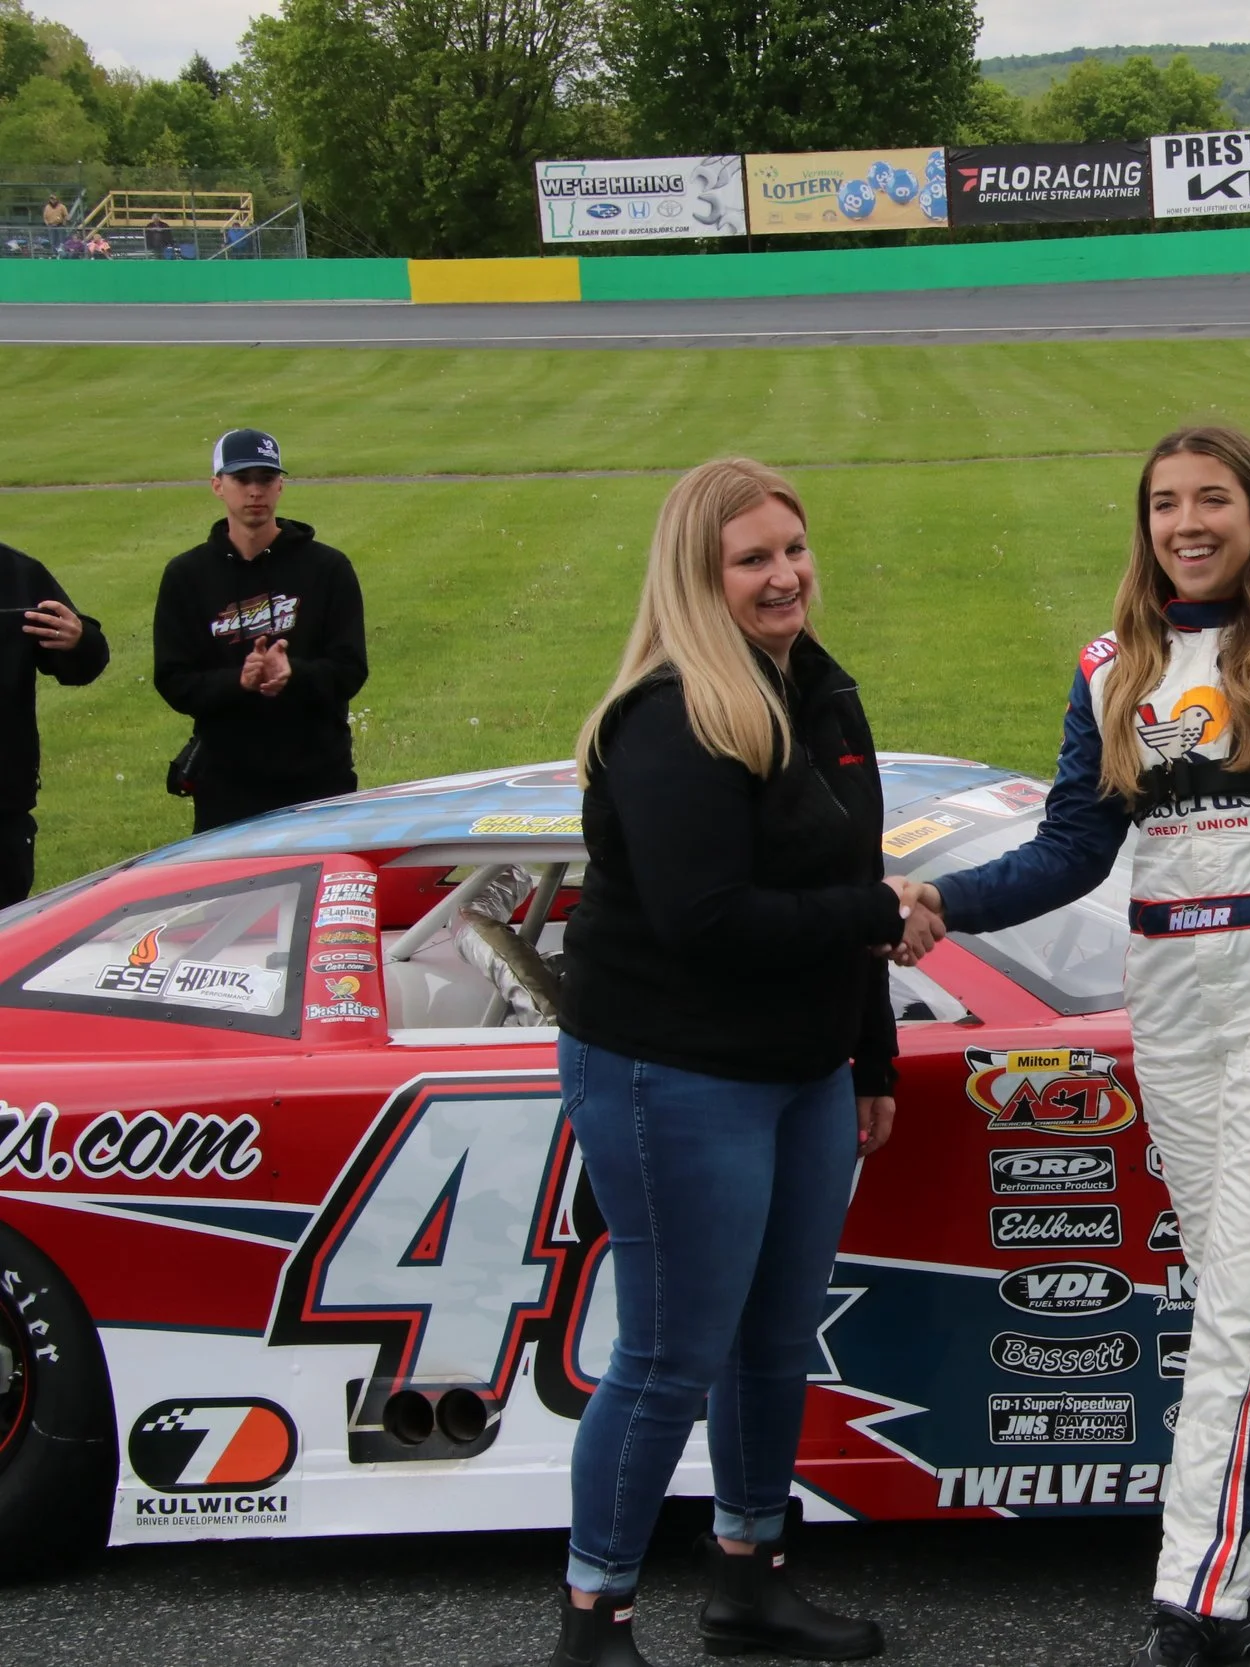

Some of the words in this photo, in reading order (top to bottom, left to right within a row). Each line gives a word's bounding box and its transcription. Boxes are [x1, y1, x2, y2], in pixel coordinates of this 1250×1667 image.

[801, 169, 845, 179] Vermont
[980, 161, 1142, 191] FLORACING
[541, 177, 607, 197] WE'RE
[610, 175, 684, 196] HIRING
[762, 178, 843, 199] LOTTERY
[978, 191, 1023, 203] OFFICIAL
[1026, 190, 1047, 201] LIVE
[1050, 189, 1091, 200] STREAM
[1093, 187, 1140, 199] PARTNER
[1192, 206, 1203, 214] THE
[578, 229, 600, 237] LEARN
[601, 228, 619, 236] MORE
[1147, 824, 1189, 836] CREDIT
[1197, 816, 1249, 831] UNION
[885, 825, 937, 848] Milton
[324, 883, 375, 894] TWELVE
[320, 893, 338, 904] 20
[329, 907, 375, 919] Laplante's
[1169, 906, 1231, 931] HOAR
[319, 953, 371, 962] GOSS
[97, 966, 168, 994] FSE
[200, 990, 250, 1001] PERFORMANCE
[307, 1001, 379, 1019] EastRise
[1017, 1055, 1060, 1068] Milton
[1071, 1053, 1090, 1066] CAT
[996, 1078, 1114, 1122] ACT
[1011, 1158, 1099, 1176] DRP
[1000, 1182, 1062, 1192] Performance
[1064, 1180, 1108, 1190] Products
[998, 1212, 1115, 1241] Edelbrock
[1025, 1272, 1110, 1299] VDL
[1029, 1300, 1053, 1308] FUEL
[1056, 1299, 1102, 1308] SYSTEMS
[1002, 1338, 1124, 1374] Bassett
[992, 1399, 1019, 1411] CD-1
[1023, 1397, 1060, 1412] Super
[1064, 1396, 1130, 1412] Speedway
[998, 1415, 1049, 1435] JMS
[1055, 1414, 1128, 1428] DAYTONA
[1054, 1428, 1125, 1441] SENSORS
[142, 1406, 253, 1484] 7
[936, 1463, 1122, 1507] TWELVE
[136, 1496, 288, 1514] KULWICKI
[136, 1517, 169, 1526] DRIVER
[172, 1516, 239, 1526] DEVELOPMENT
[242, 1514, 287, 1524] PROGRAM
